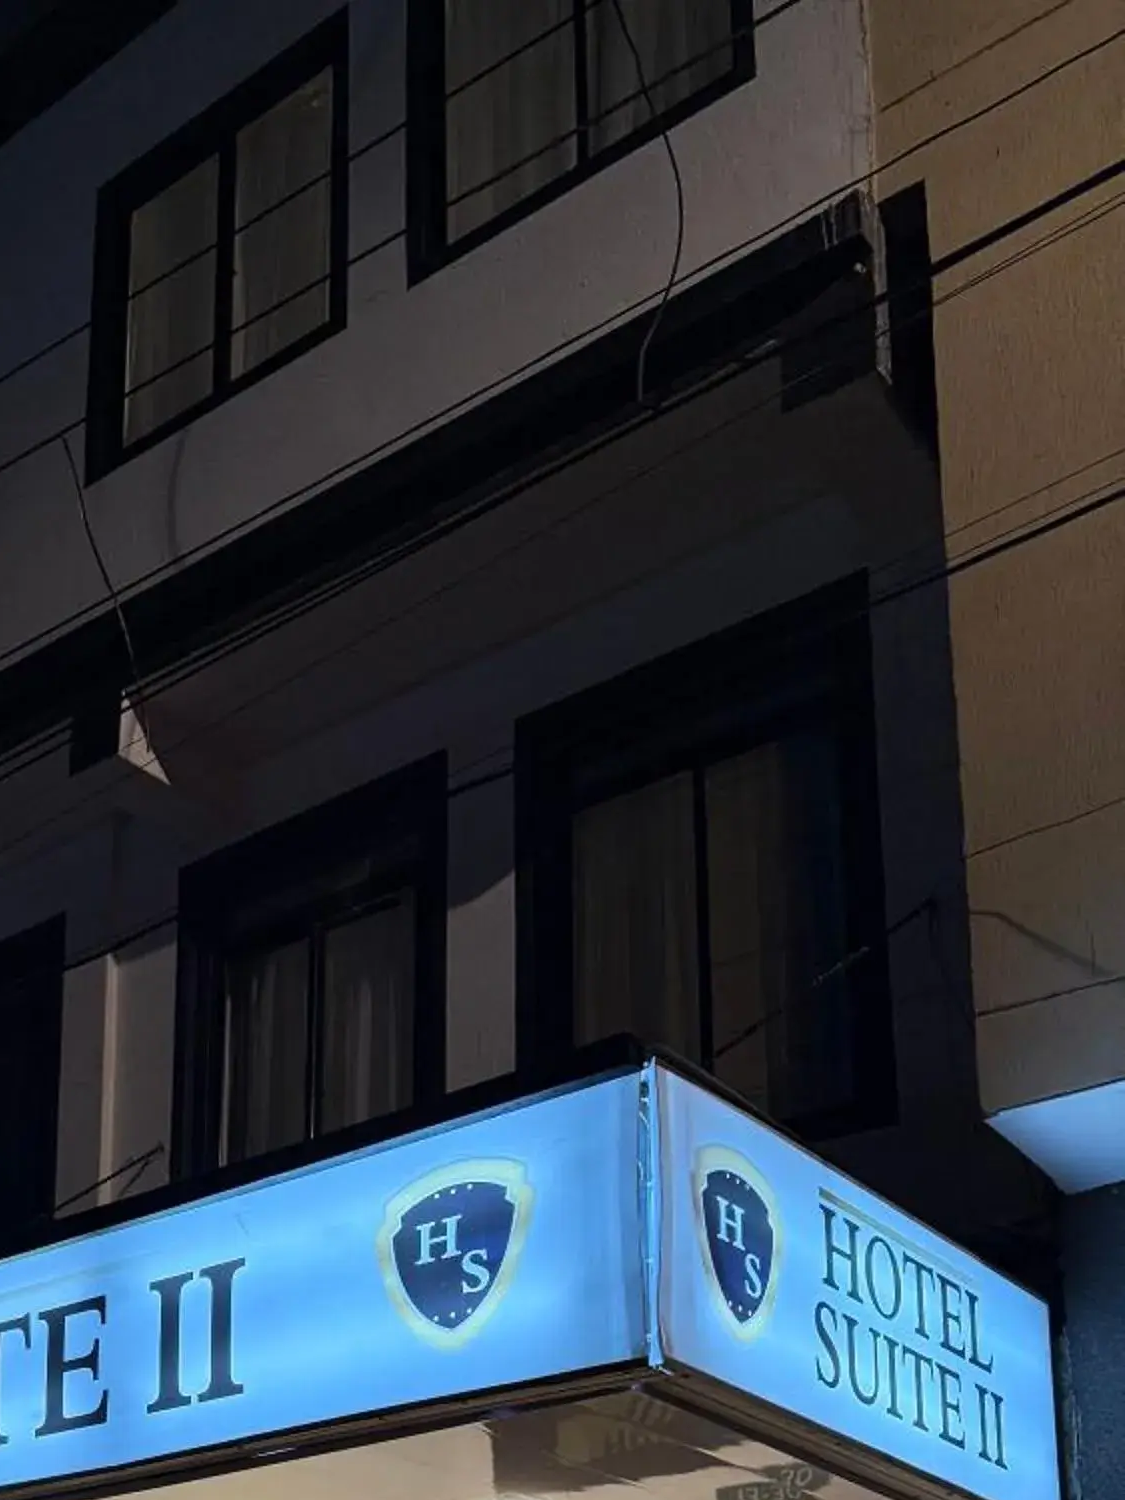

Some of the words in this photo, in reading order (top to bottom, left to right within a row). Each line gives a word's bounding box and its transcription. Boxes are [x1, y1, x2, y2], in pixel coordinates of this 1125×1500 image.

[146, 1257, 246, 1414] II
[818, 1202, 994, 1375] HOTEL
[814, 1300, 966, 1450] SUITE
[974, 1383, 1008, 1471] II
